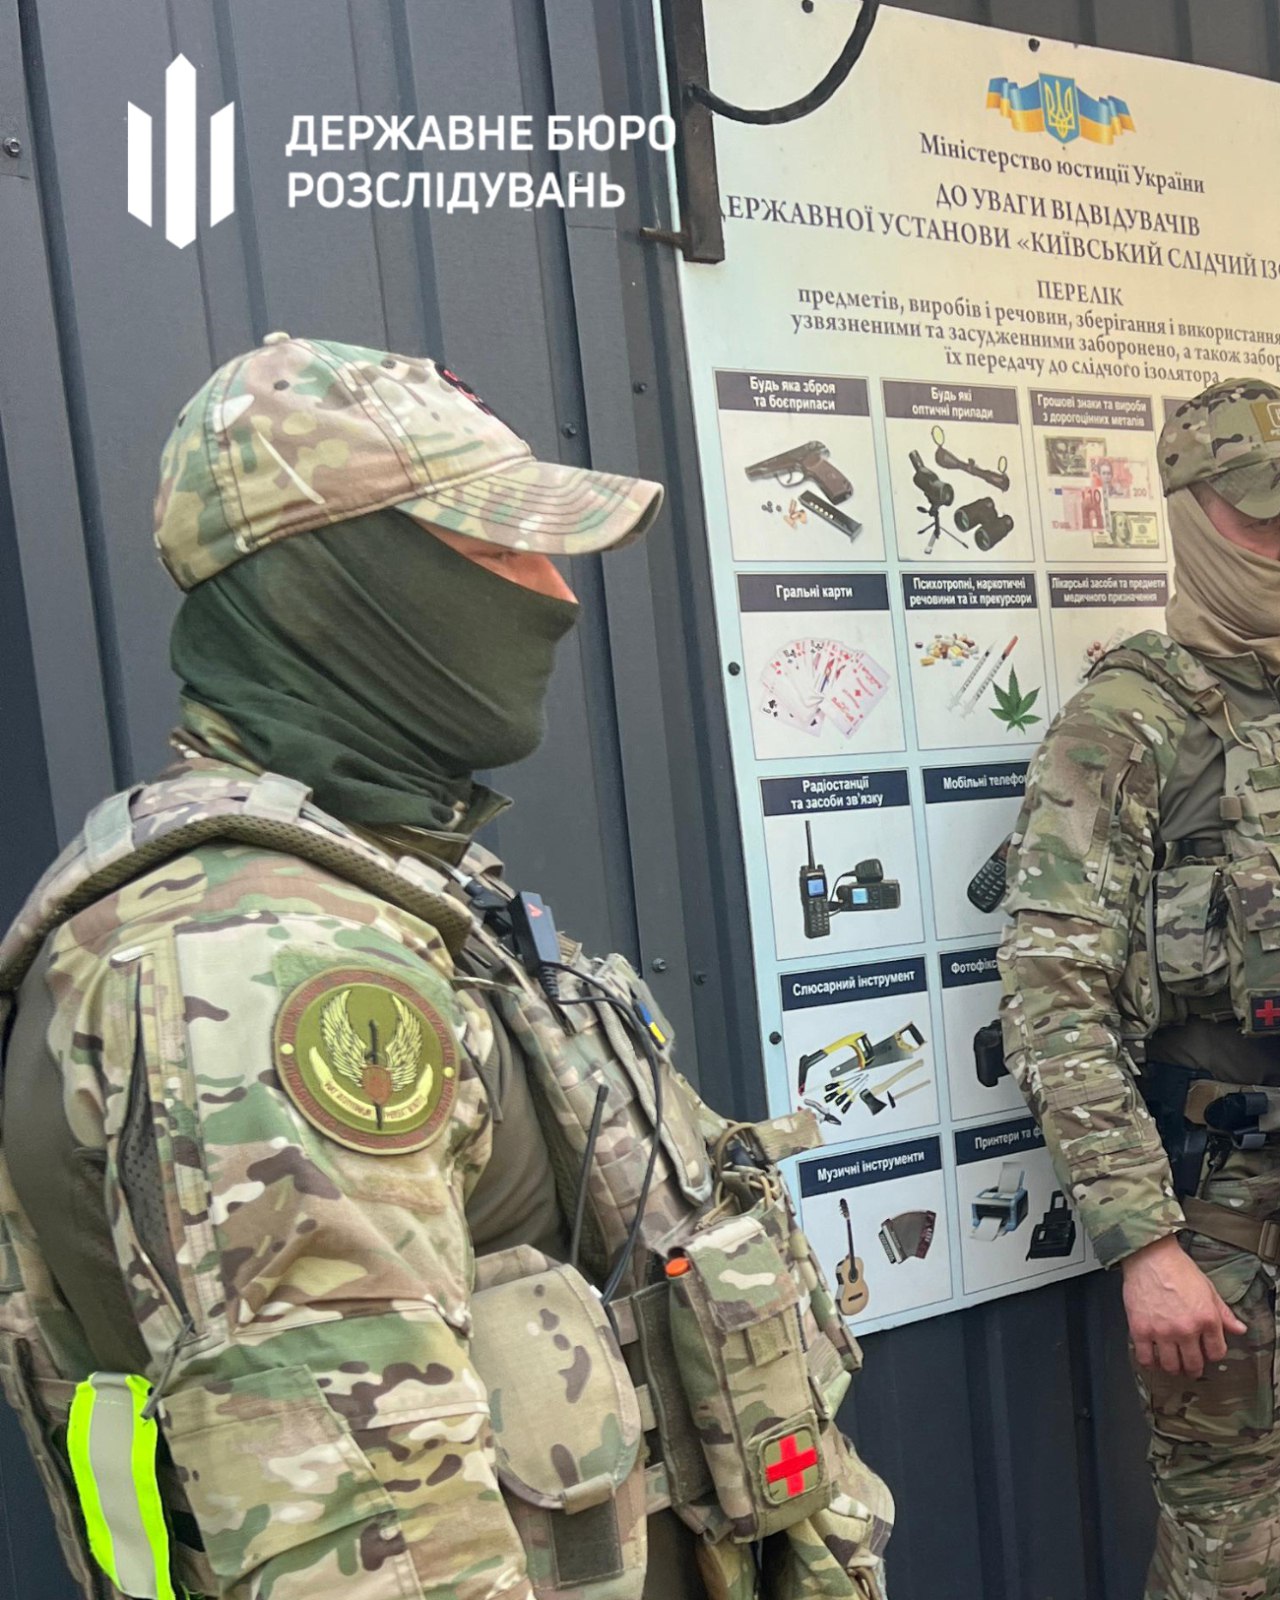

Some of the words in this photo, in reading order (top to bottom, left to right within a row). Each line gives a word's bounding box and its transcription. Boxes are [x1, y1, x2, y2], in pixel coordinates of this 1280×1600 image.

[919, 131, 1052, 173] Міністерство
[1057, 159, 1130, 184] юстиції
[1133, 164, 1205, 194] України
[936, 182, 968, 209] ДО
[972, 187, 1048, 218] УВАГИ
[1051, 198, 1201, 237] ВІДВІДУВАЧІВ
[721, 194, 876, 233] ЕРЖАВНОЇ
[877, 212, 1011, 250] УСТАНОВИ
[1016, 230, 1164, 267] «КИЇВСЬКИЙ
[1167, 247, 1258, 277] СЛІДЧИЙ
[1036, 279, 1124, 307] ПЕРЕЛІК
[798, 288, 904, 315] предметів,
[909, 295, 982, 320] виробів
[984, 301, 992, 319] і
[994, 307, 1074, 330] речовин,
[1076, 309, 1167, 337] зберігання
[1168, 317, 1176, 336] і
[790, 313, 922, 338] узвязненими
[925, 323, 945, 340] та
[948, 326, 1076, 351] засудженними
[1078, 334, 1181, 362] заборонено,
[1182, 346, 1192, 360] а
[1194, 346, 1242, 364] також
[944, 345, 962, 366] їх
[965, 352, 1045, 377] передачу
[1048, 359, 1069, 375] до
[1071, 357, 1141, 379] слідчого
[1143, 361, 1220, 387] ізолятора
[749, 376, 780, 394] Будь
[781, 380, 802, 393] яка
[802, 380, 836, 395] зброя
[931, 387, 956, 402] Будь
[958, 389, 973, 402] які
[753, 396, 767, 408] та
[768, 396, 836, 411] боєприпаси
[912, 404, 951, 417] оптичні
[951, 407, 993, 420] прилади
[1037, 394, 1075, 409] Грошові
[1077, 400, 1101, 409] знаки
[1103, 401, 1113, 410] та
[1115, 401, 1147, 414] вироби
[1042, 413, 1049, 422] з
[1050, 412, 1109, 425] дорогоцінних
[1111, 416, 1145, 427] металів
[776, 584, 820, 599] Гральні
[822, 586, 853, 599] карти
[913, 577, 975, 592] Психотропні,
[976, 577, 1026, 592] наркотичні
[1090, 577, 1118, 589] засоби
[1119, 579, 1128, 589] та
[910, 594, 956, 607] речовини
[957, 593, 968, 605] та
[969, 592, 978, 605] їх
[979, 594, 1032, 607] прекурсори
[802, 776, 870, 795] Радіостанції
[943, 773, 988, 790] Мобільні
[988, 771, 1026, 788] телефо
[790, 799, 804, 810] та
[805, 795, 844, 809] засоби
[950, 958, 998, 975] Фотофікс
[792, 976, 857, 997] Слюсарний
[857, 969, 916, 988] інструмент
[974, 1131, 1020, 1151] Принтери
[1021, 1129, 1032, 1139] та
[817, 1162, 861, 1182] Музичні
[861, 1150, 925, 1173] інструменти
